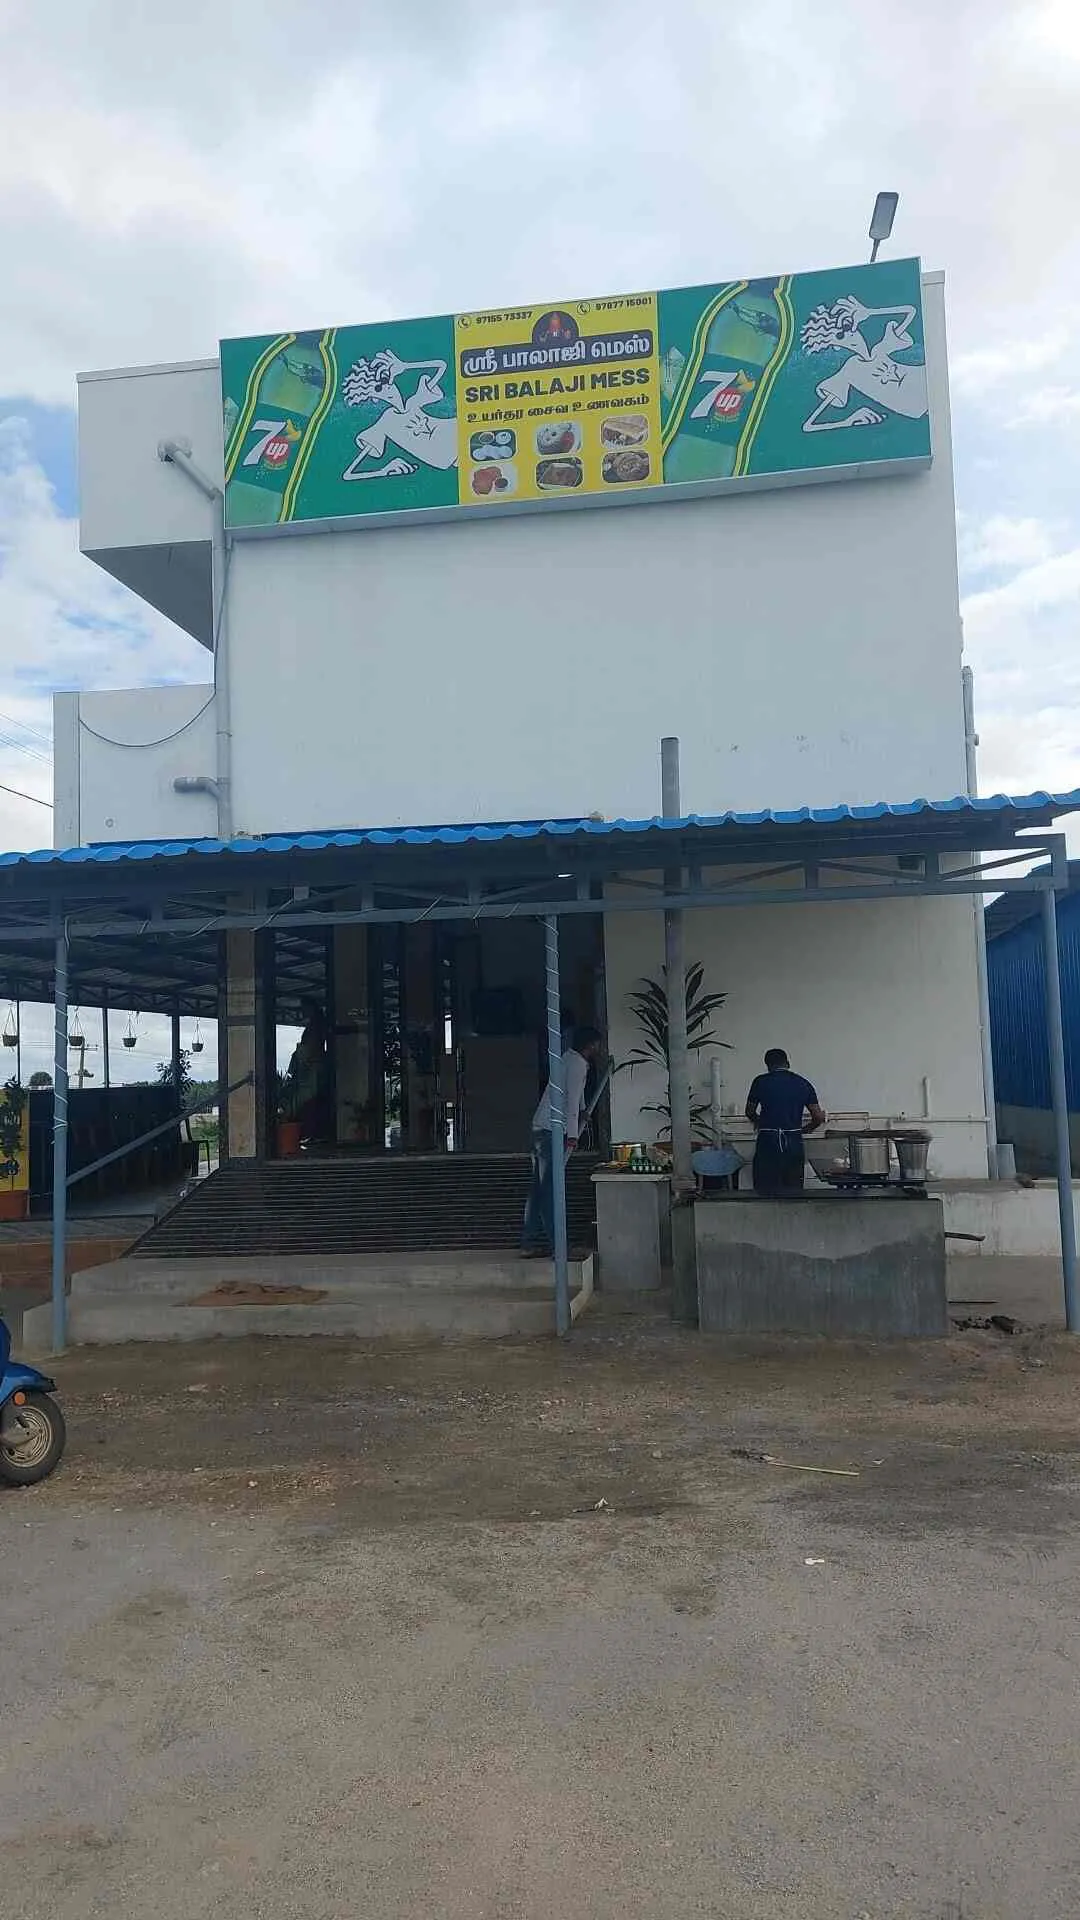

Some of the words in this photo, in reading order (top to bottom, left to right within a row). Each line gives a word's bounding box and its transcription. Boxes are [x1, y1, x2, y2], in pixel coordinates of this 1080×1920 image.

[502, 340, 585, 368] பாலாஜி
[591, 334, 650, 357] மெஸ்
[465, 384, 500, 403] SRI
[504, 375, 585, 399] BALAJI
[591, 368, 650, 390] MESS
